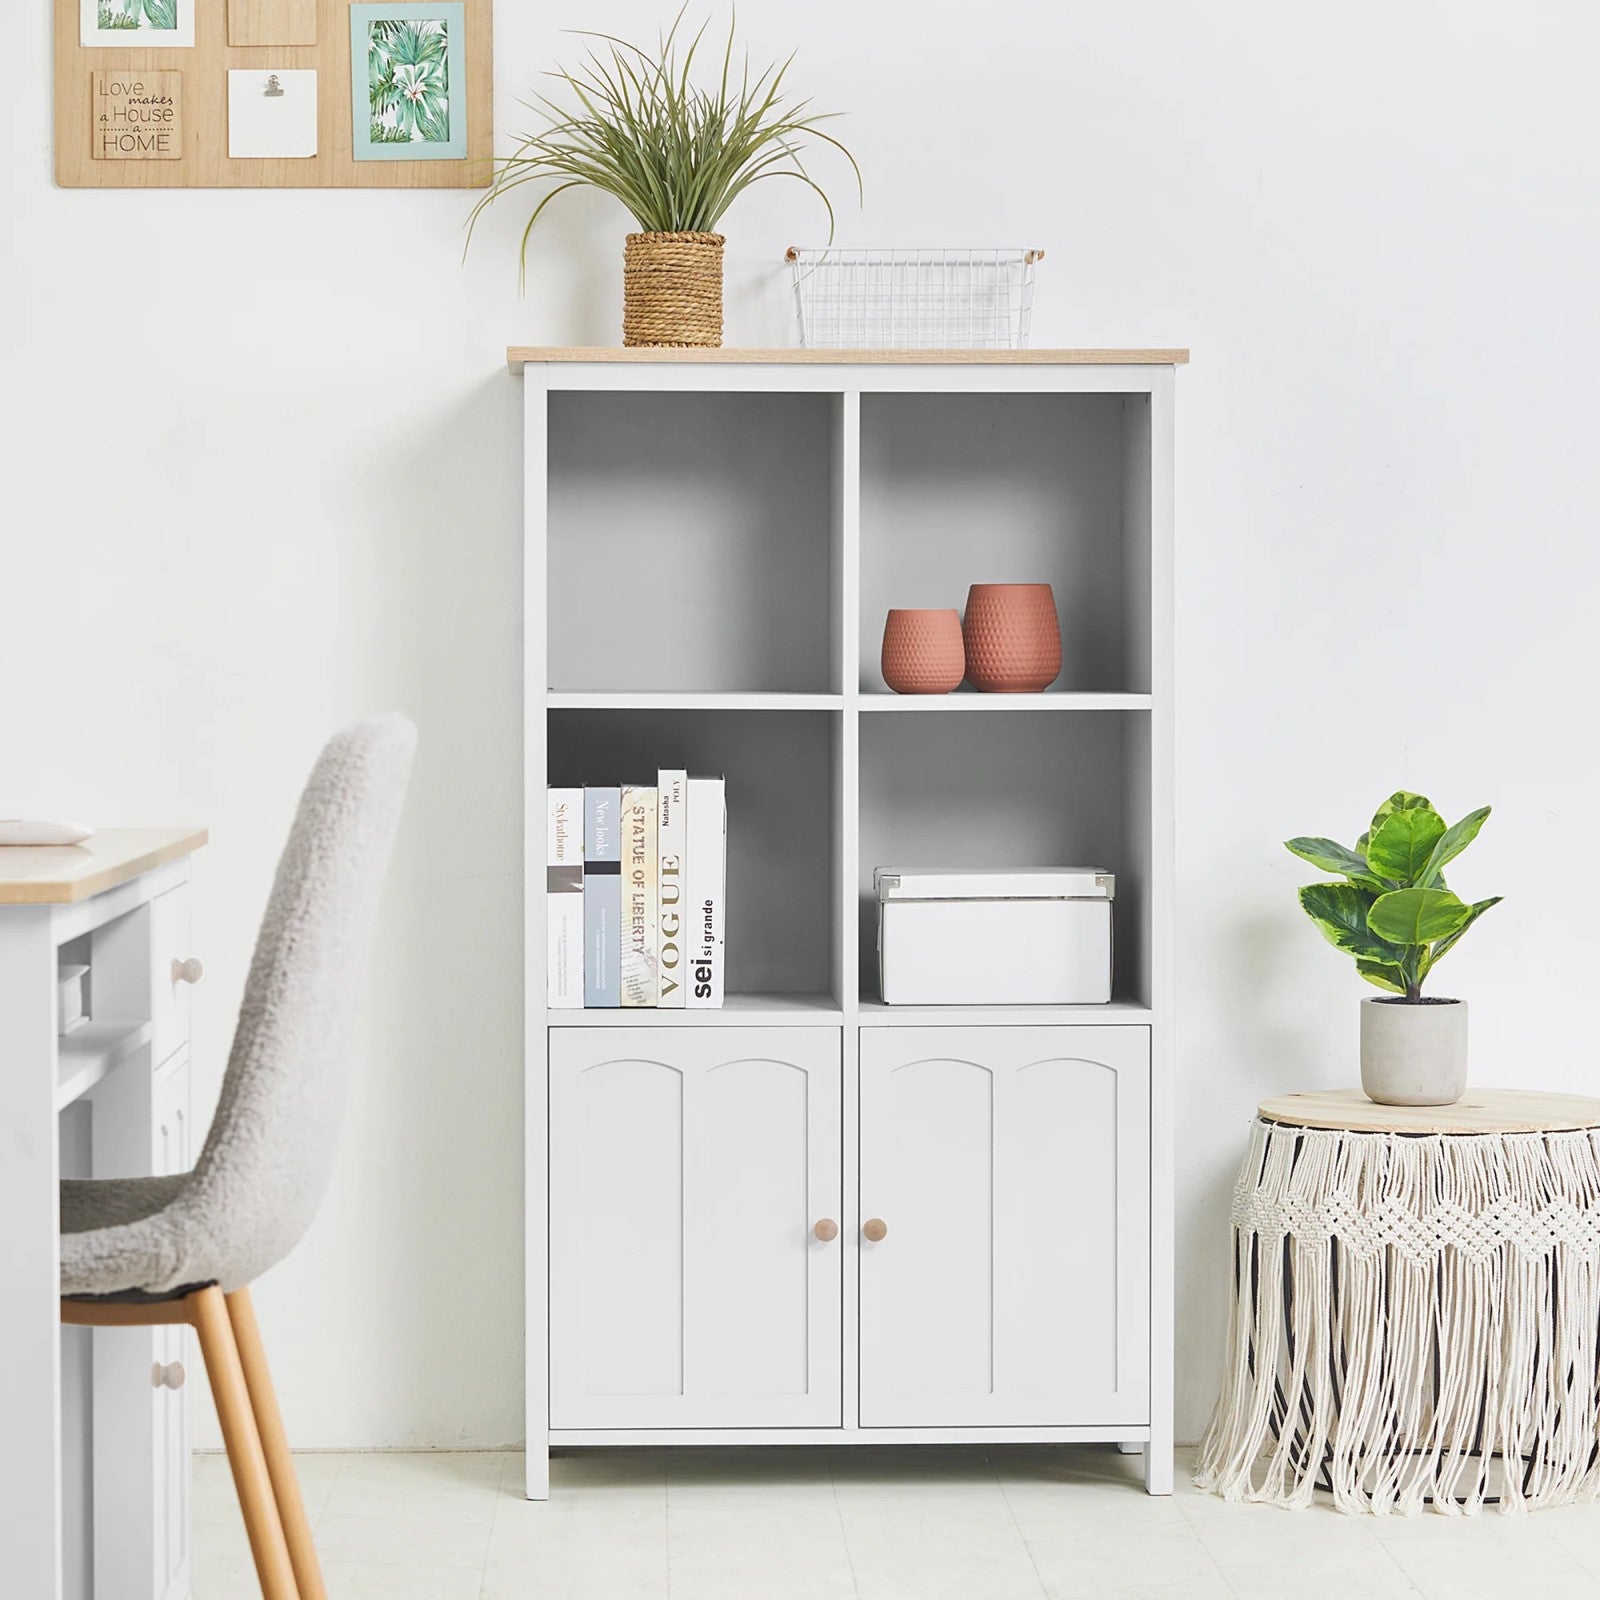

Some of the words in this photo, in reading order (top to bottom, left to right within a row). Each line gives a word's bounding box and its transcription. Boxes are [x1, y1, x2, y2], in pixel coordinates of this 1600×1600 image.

[99, 79, 145, 96] Love
[128, 94, 174, 105] makes
[100, 114, 109, 122] a
[113, 106, 174, 122] House
[132, 125, 142, 133] a
[103, 134, 170, 152] HOME
[595, 800, 609, 826] New
[662, 795, 670, 827] Natasha
[595, 827, 609, 856] looks
[632, 806, 646, 865] STATUE
[632, 869, 646, 890] OF
[632, 893, 646, 955] LIBERTY
[661, 855, 680, 998] VOGUE
[702, 899, 715, 943] grande
[701, 945, 713, 957] si
[690, 959, 713, 999] sei
